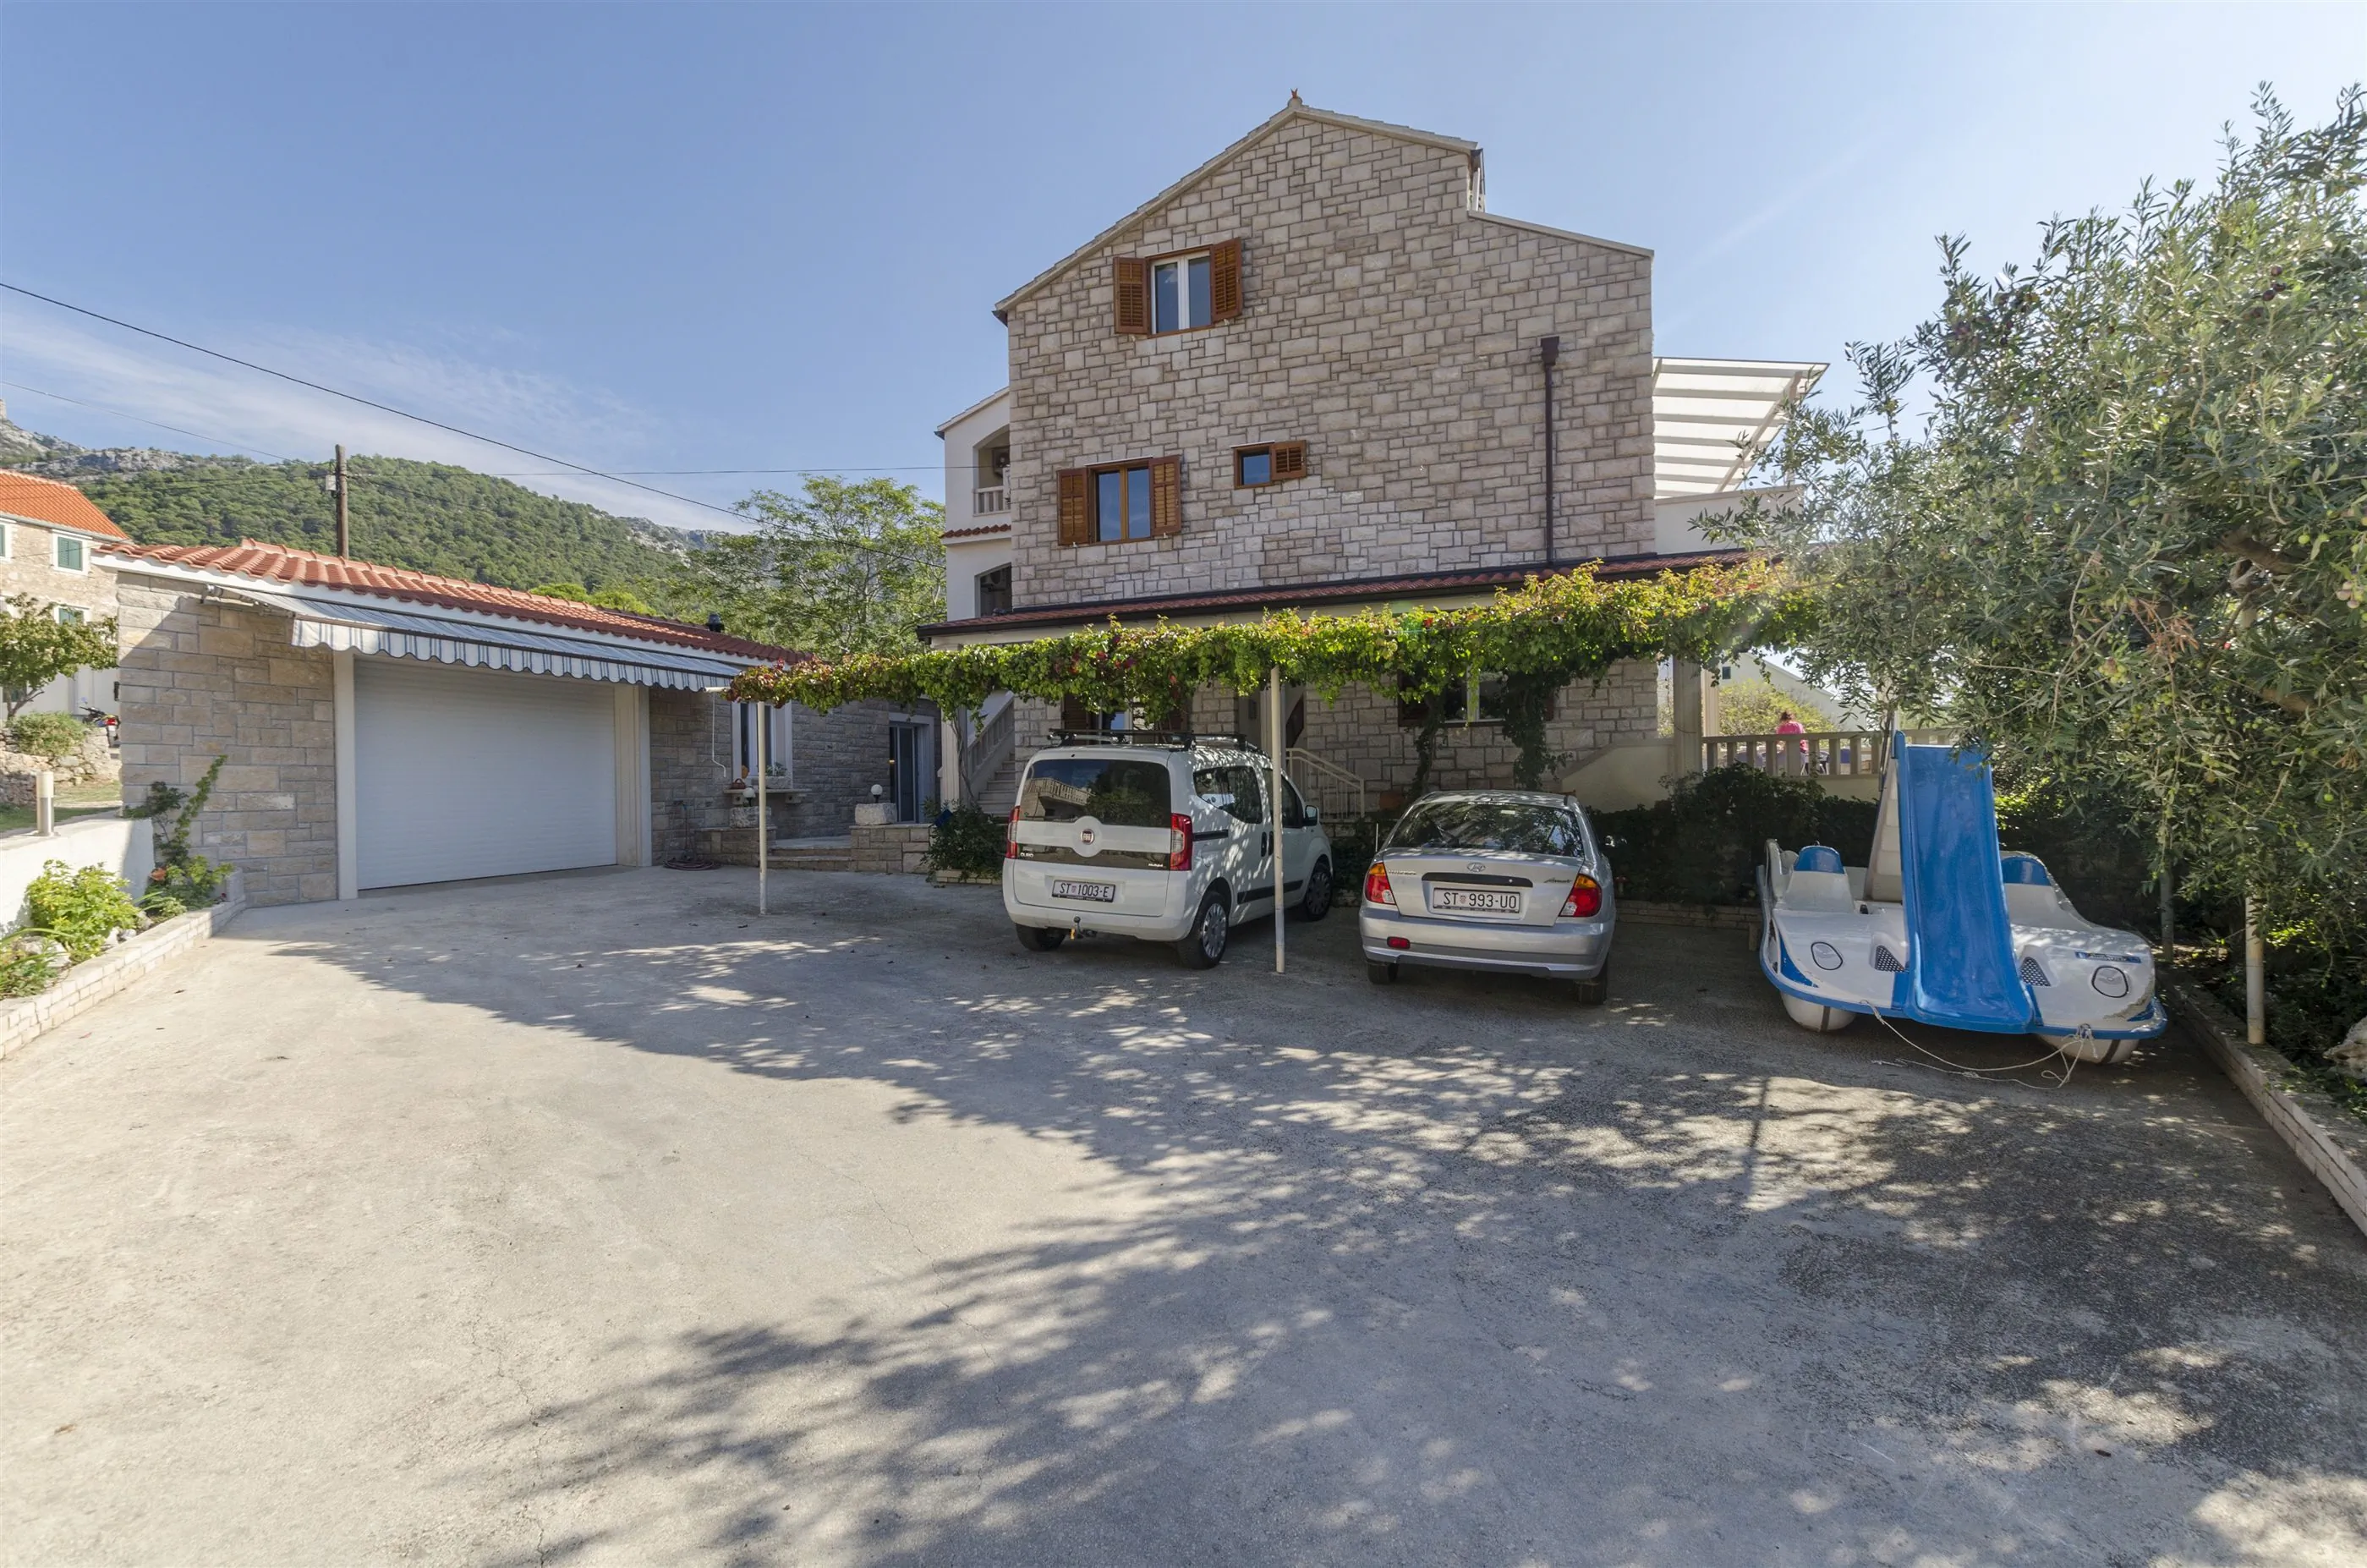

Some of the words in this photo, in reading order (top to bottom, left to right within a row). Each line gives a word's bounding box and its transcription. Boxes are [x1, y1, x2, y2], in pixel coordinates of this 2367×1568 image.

[1060, 882, 1071, 894] ST
[1078, 884, 1110, 897] 1003-E
[1443, 891, 1459, 905] ST
[1469, 893, 1516, 908] 993-UO
